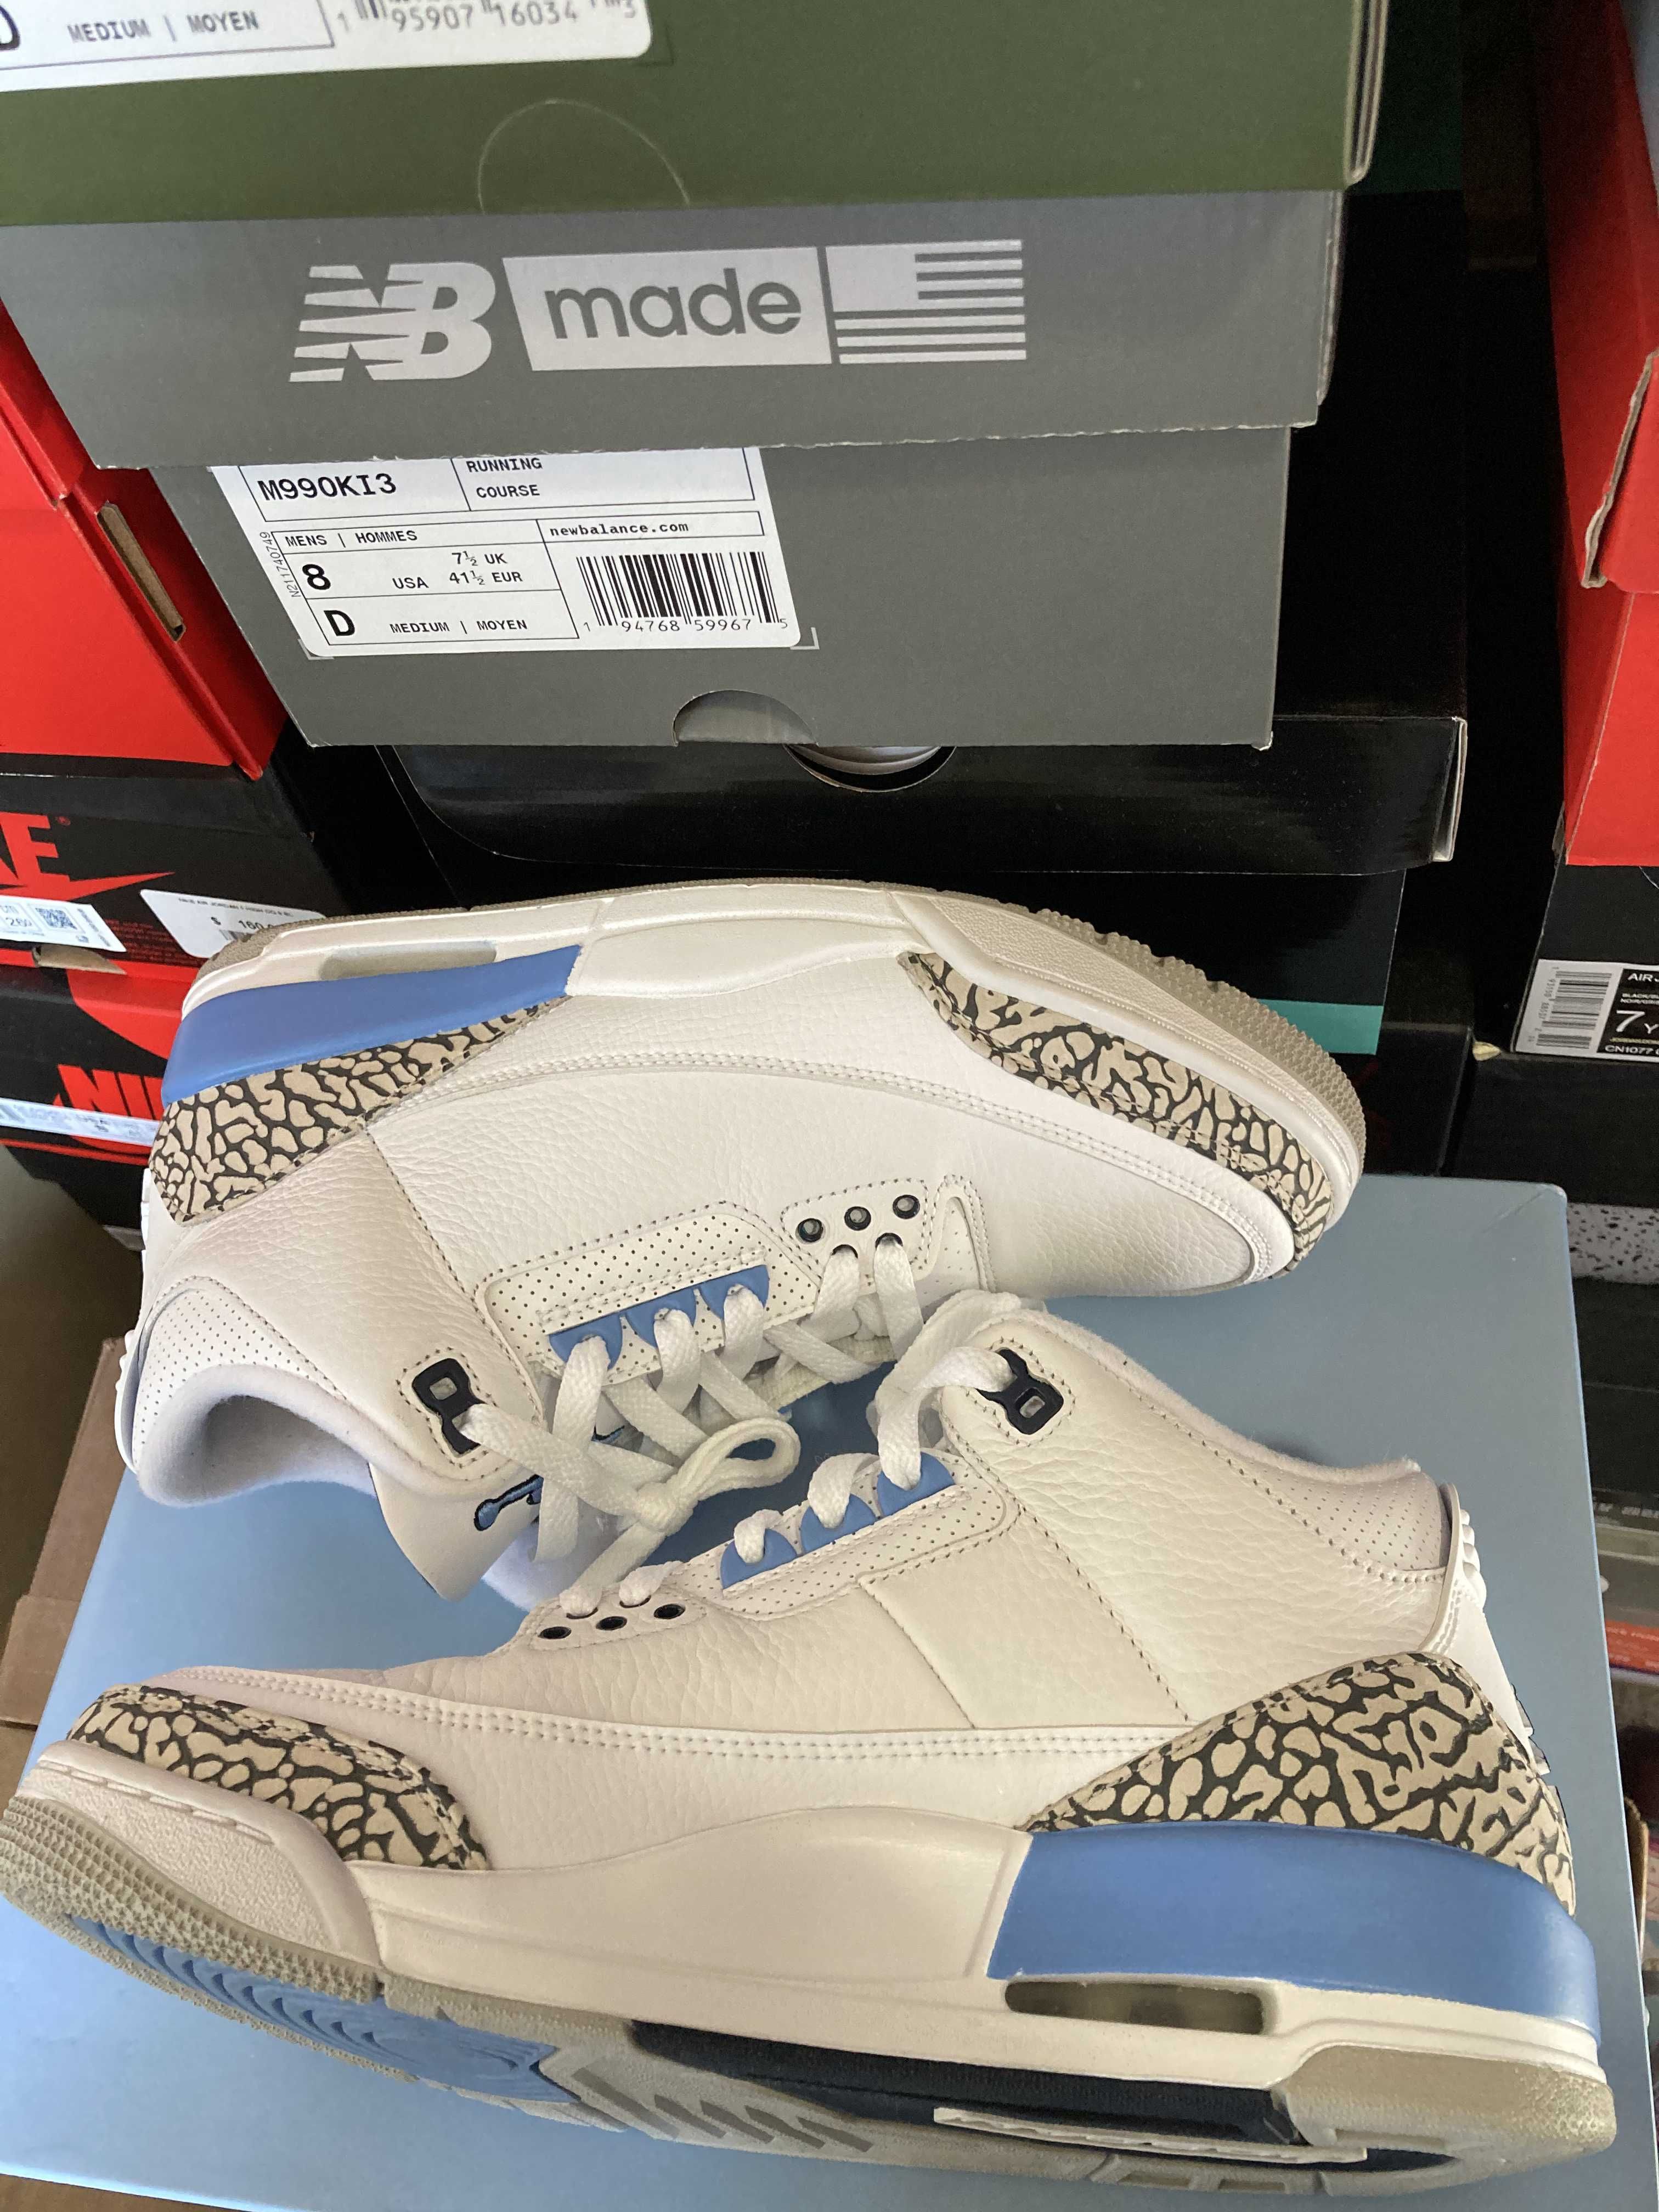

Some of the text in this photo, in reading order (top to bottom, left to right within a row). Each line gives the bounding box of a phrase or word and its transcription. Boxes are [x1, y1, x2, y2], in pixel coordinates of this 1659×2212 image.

[67, 11, 259, 43] MEDIUM MOYEN
[391, 6, 473, 32] 95907
[544, 268, 802, 341] made
[289, 262, 496, 382] NB
[466, 457, 543, 472] RUNNING
[257, 473, 397, 501] M990KI3
[476, 484, 540, 498] COURSE
[550, 522, 689, 537] newbalance.com
[285, 530, 418, 547] MENS HOMMES
[484, 553, 507, 565] UK
[302, 564, 331, 590] 8
[392, 577, 429, 590] USA
[492, 571, 523, 583] EUR
[324, 609, 356, 636] D
[390, 619, 528, 634] MEDIUM MOYEN
[584, 618, 788, 632] 1 94768 59967 5
[1628, 973, 1654, 983] AIR
[1616, 1009, 1645, 1032] 7
